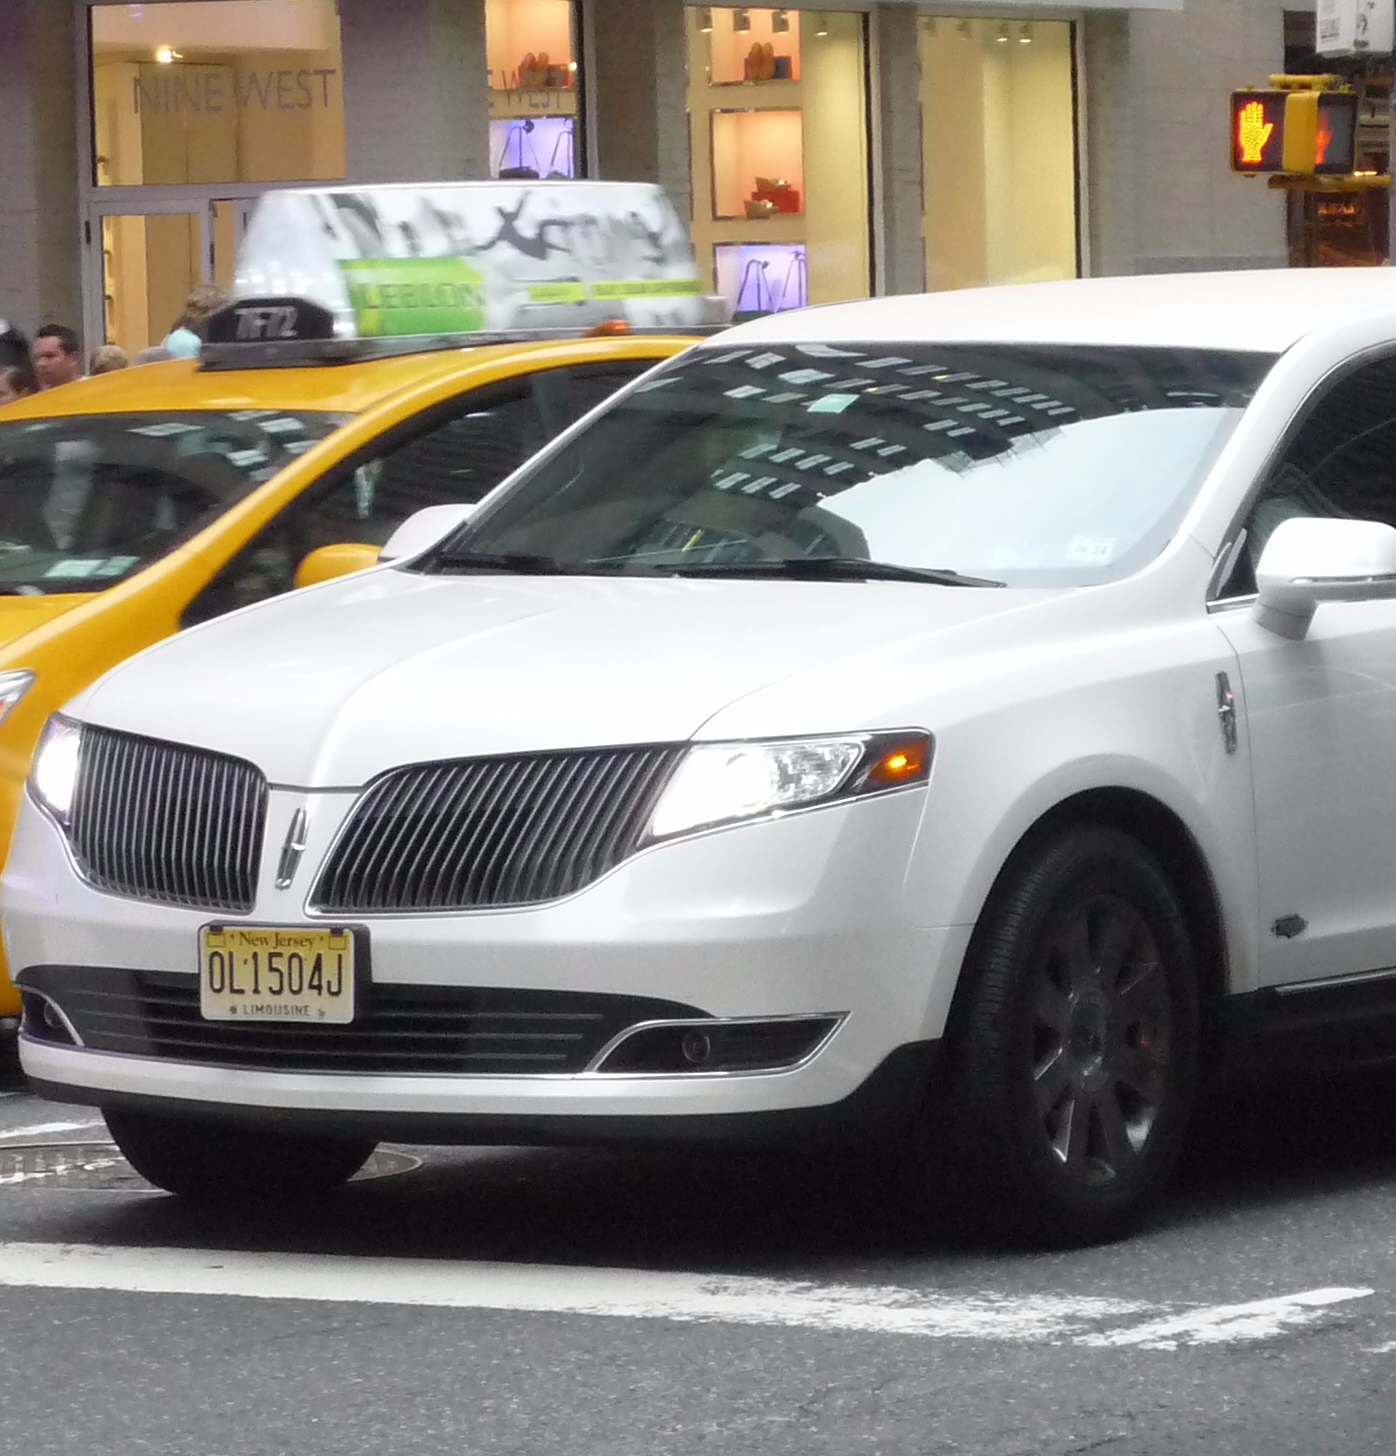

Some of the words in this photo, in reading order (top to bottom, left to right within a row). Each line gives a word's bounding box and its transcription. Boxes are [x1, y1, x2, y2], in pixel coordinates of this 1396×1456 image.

[133, 72, 223, 113] NINE
[232, 68, 337, 110] WEST
[238, 931, 269, 947] New
[273, 932, 315, 951] Jersey
[243, 1004, 311, 1016] LIMOUSINE
